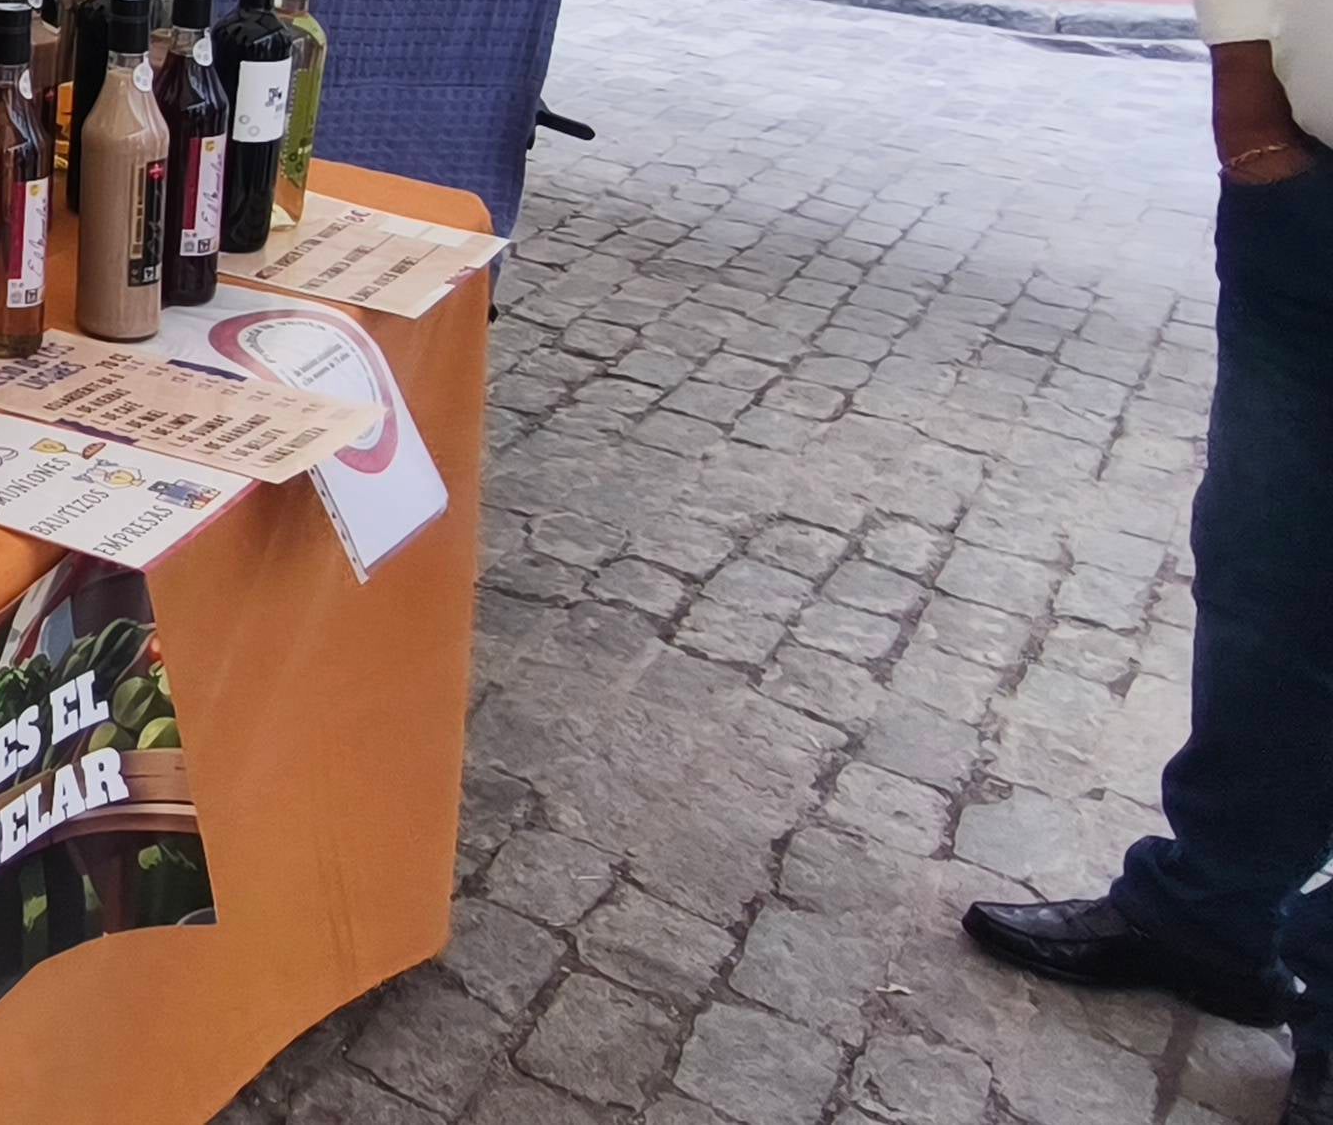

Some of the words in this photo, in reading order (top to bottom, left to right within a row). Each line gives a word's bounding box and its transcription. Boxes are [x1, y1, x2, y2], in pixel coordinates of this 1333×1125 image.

[30, 488, 110, 537] BAUTIZOS
[93, 504, 174, 557] EMPRESAS
[50, 670, 109, 745] EL
